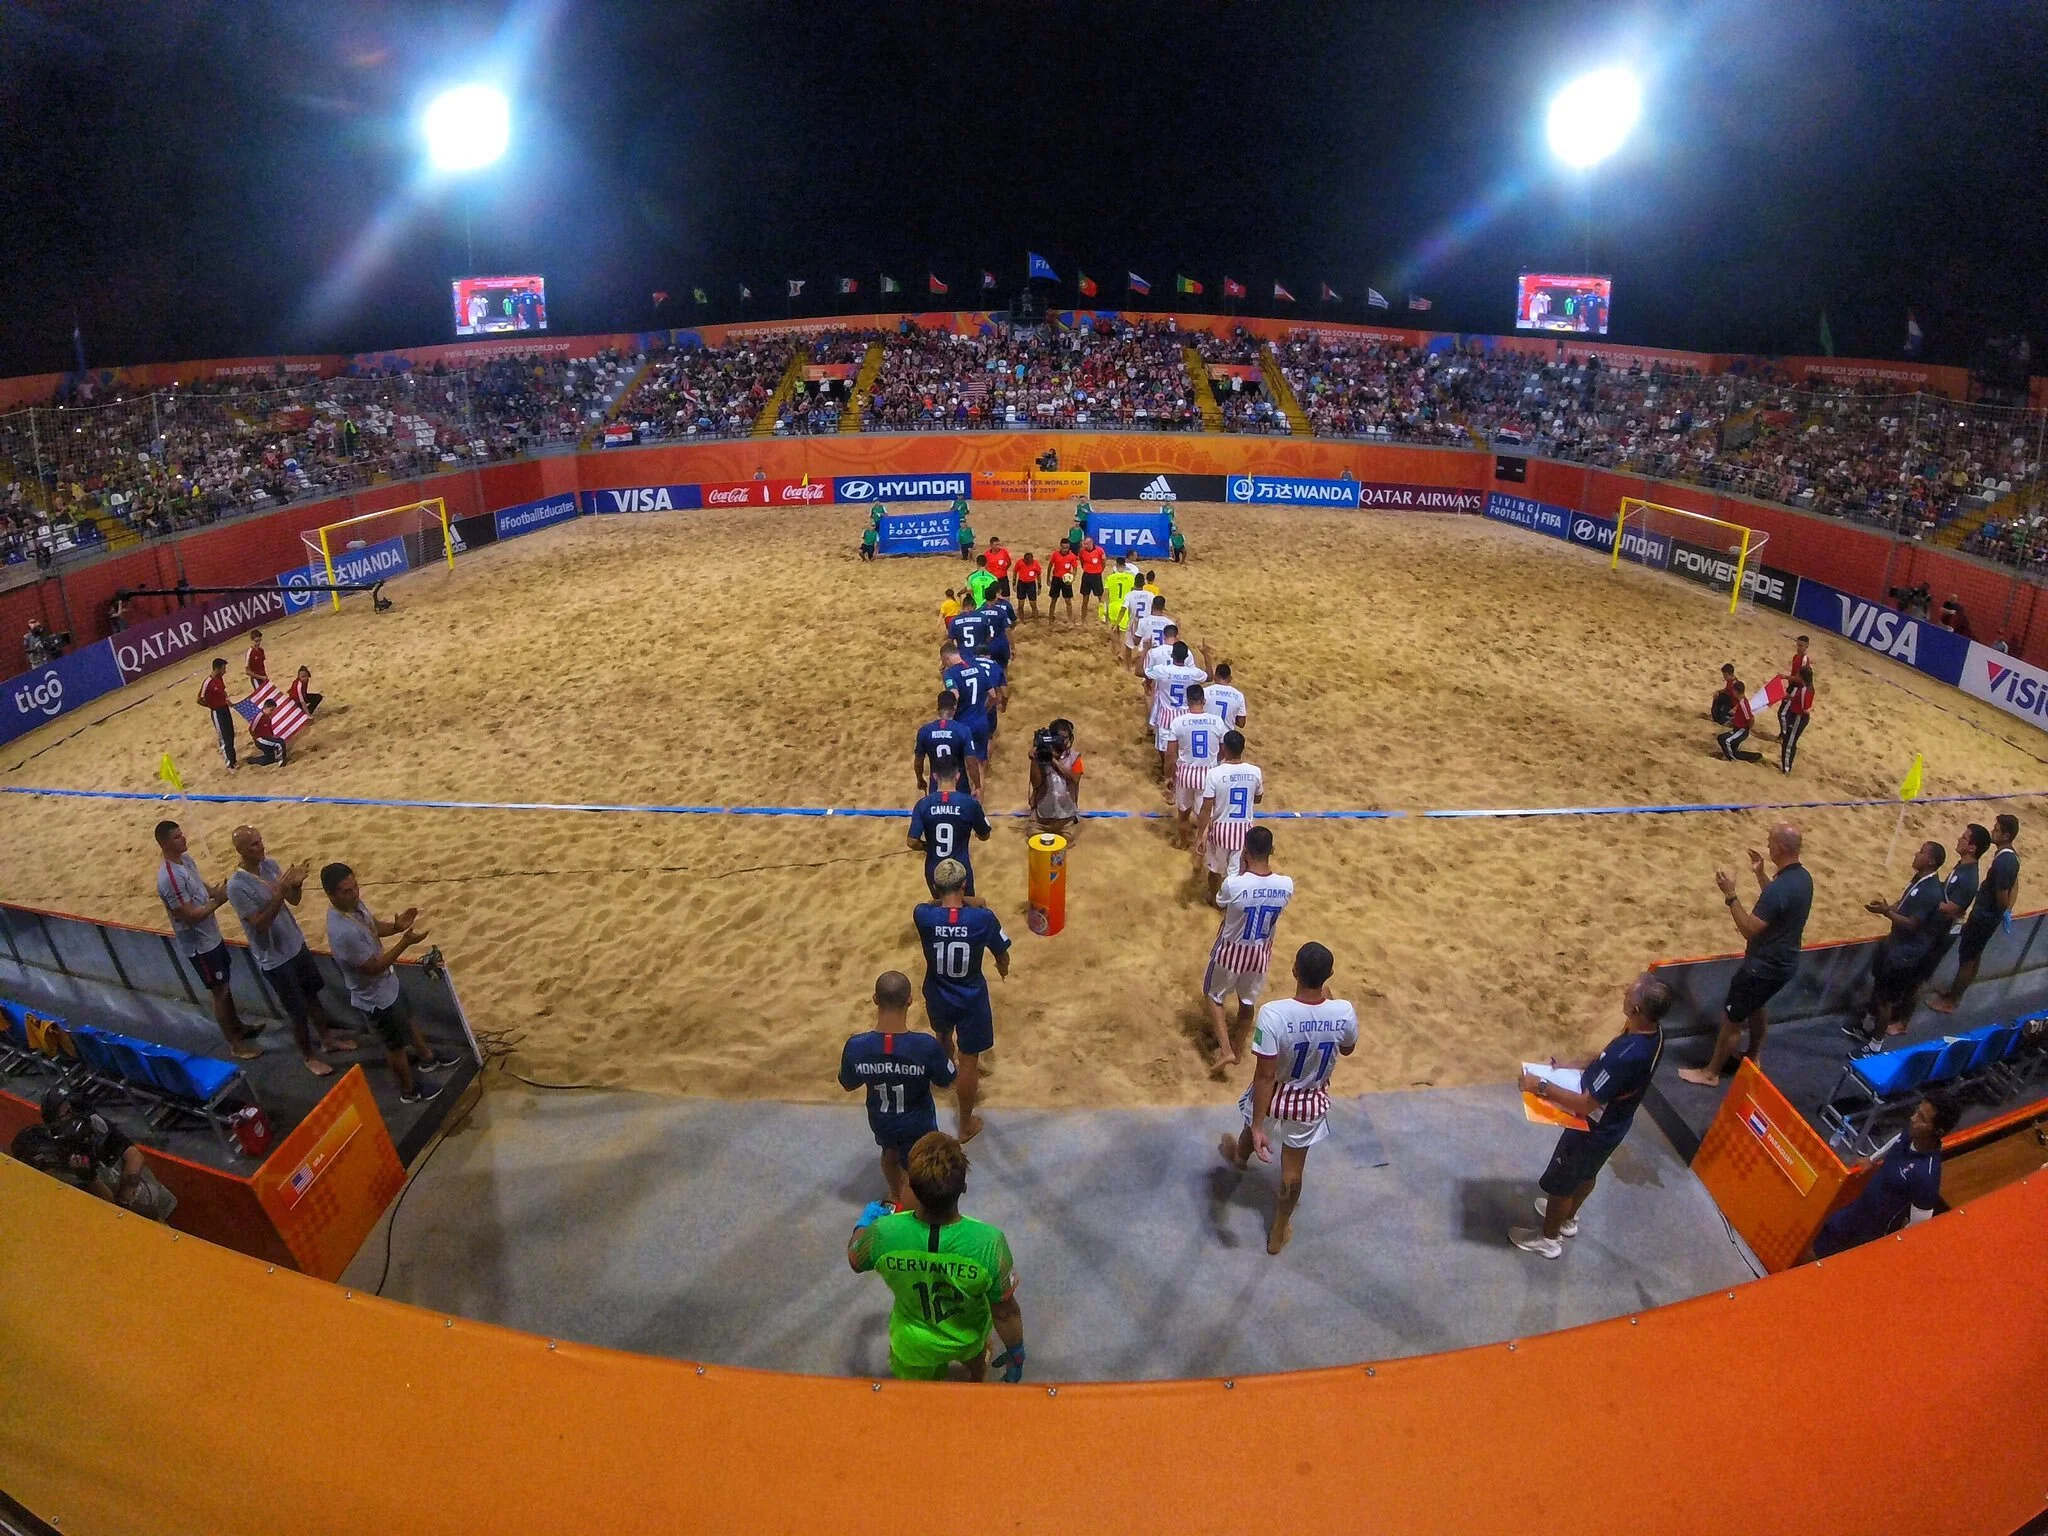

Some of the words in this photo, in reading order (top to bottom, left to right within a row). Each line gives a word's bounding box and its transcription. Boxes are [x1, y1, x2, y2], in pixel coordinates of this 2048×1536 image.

[744, 328, 770, 336] BEACH
[1333, 329, 1361, 339] SOCCER
[1362, 332, 1388, 341] WORLD
[1390, 334, 1405, 342] CUP
[444, 350, 463, 359] FIFA
[464, 347, 491, 357] BEACH
[493, 345, 524, 354] SOCCER
[525, 343, 554, 353] WORLD
[555, 342, 570, 351] CUP
[878, 480, 965, 496] HYUNDAI
[1140, 491, 1177, 500] adidas
[1256, 483, 1293, 499] 万达
[1293, 484, 1353, 501] WANDA
[607, 488, 673, 512] VISA
[1360, 489, 1413, 505] QATAR
[1415, 492, 1481, 510] AIRWAYS
[1491, 495, 1534, 514] LIVING
[499, 501, 575, 532] #FootballEducates
[889, 519, 950, 530] LIVING
[1489, 505, 1532, 525] FOOTBALL
[1540, 511, 1562, 529] FIFA
[889, 526, 950, 536] FOOTBALL
[1098, 528, 1157, 546] FIFA
[922, 538, 950, 548] FIFA
[1597, 526, 1664, 561] HYUNDAI
[346, 548, 402, 581] WANDA
[1674, 548, 1785, 601] POWERADE
[1118, 582, 1123, 598] 1
[1136, 602, 1146, 618] 2
[117, 621, 198, 673] QATAR
[202, 592, 284, 639] AIRWAYS
[963, 626, 975, 648] 5
[1152, 629, 1164, 646] 3
[1835, 593, 1919, 665] VISA
[965, 677, 978, 705] 7
[1170, 684, 1184, 708] 5
[1215, 701, 1228, 721] 7
[1191, 730, 1208, 759] 8
[930, 805, 960, 816] CANALE
[1229, 787, 1248, 819] 9
[935, 823, 954, 857] 9
[1252, 887, 1287, 900] ESCOBAR
[935, 926, 968, 938] REYES
[1241, 905, 1283, 941] 10
[933, 941, 970, 979] 10
[1299, 1019, 1347, 1033] GONZALEZ
[854, 1061, 926, 1076] MONDRAGON
[1291, 1041, 1335, 1082] 11
[873, 1082, 905, 1115] 11
[886, 1256, 979, 1280] CERVANTES
[912, 1280, 966, 1325] 12
